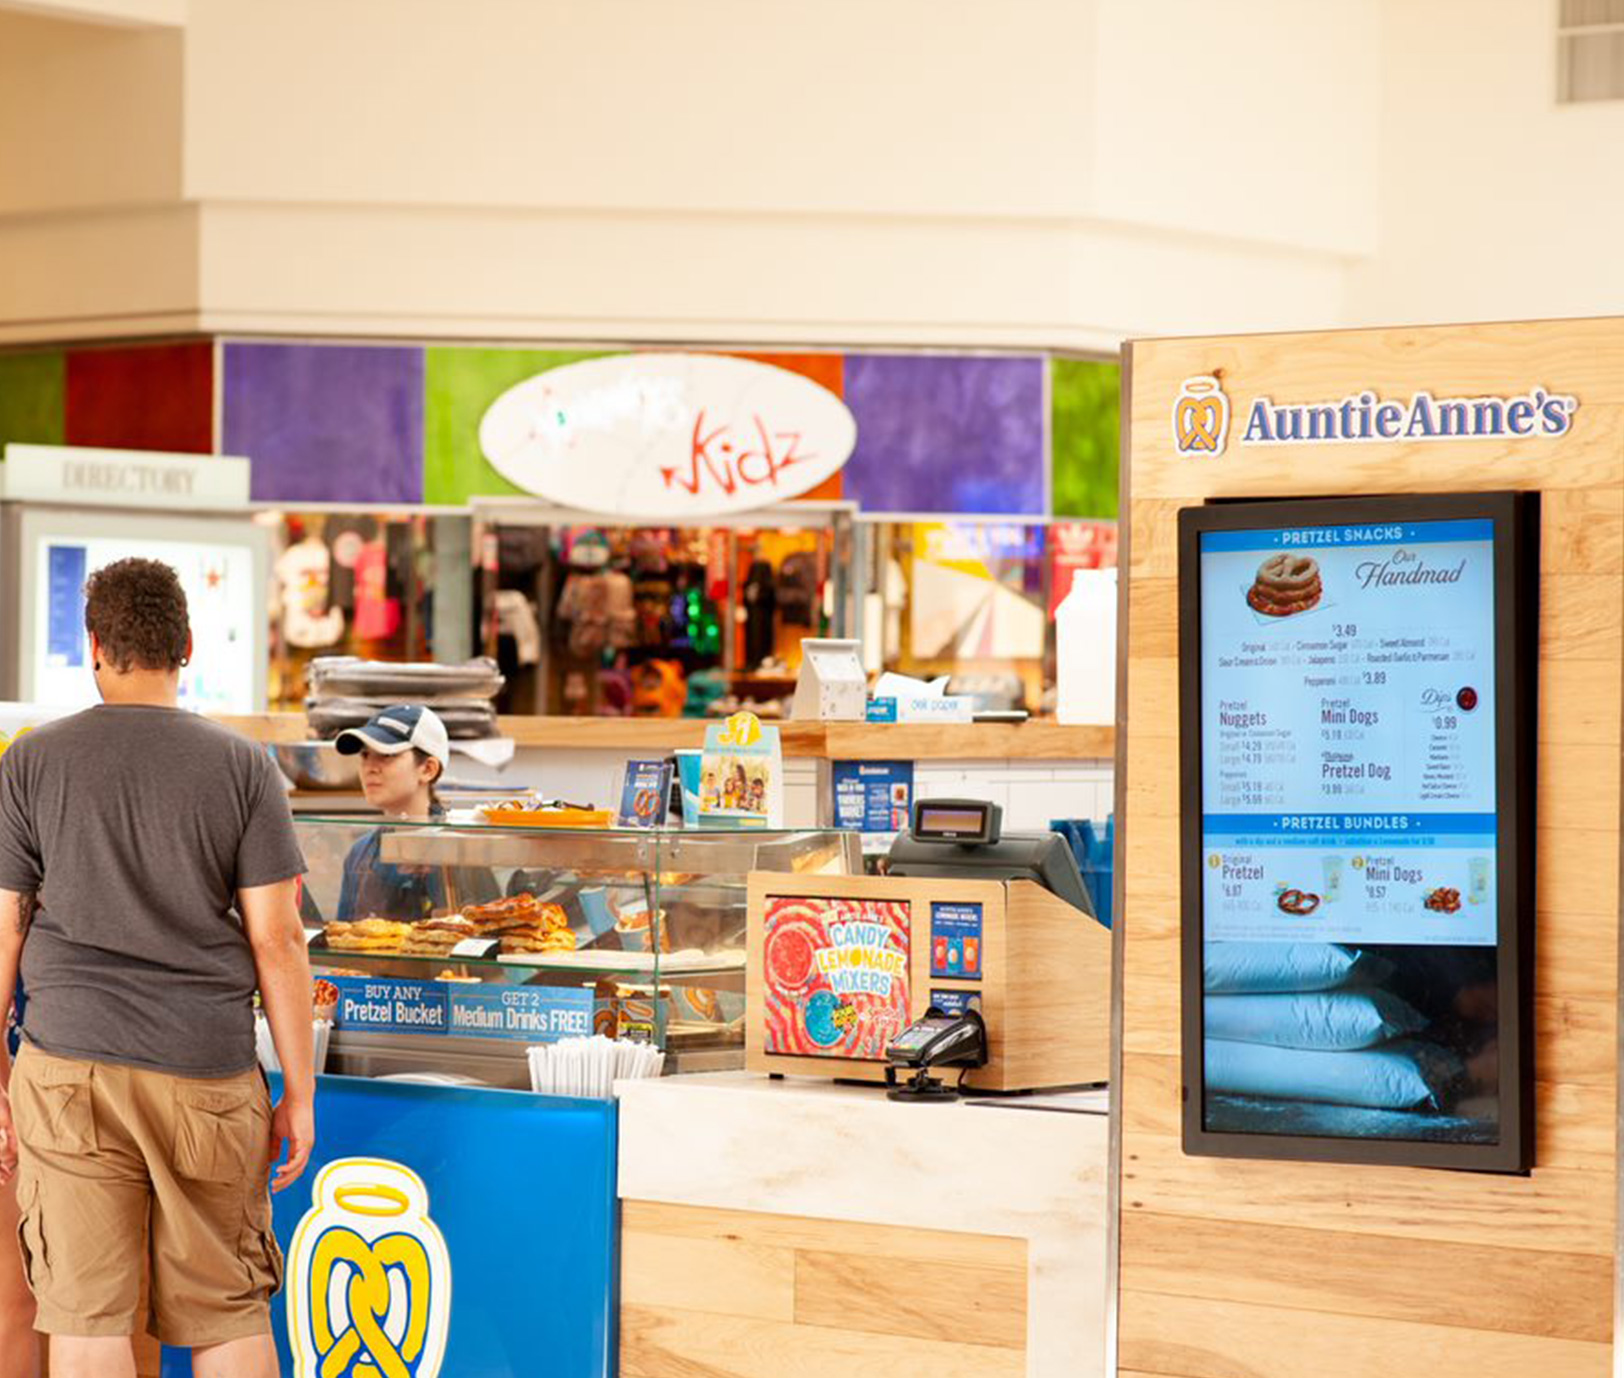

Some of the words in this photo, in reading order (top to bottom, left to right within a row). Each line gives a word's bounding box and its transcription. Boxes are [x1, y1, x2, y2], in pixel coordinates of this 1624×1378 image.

[661, 408, 818, 495] Kidz
[63, 461, 195, 495] DIRECTORY
[1282, 529, 1340, 545] PRETZEL
[1344, 526, 1403, 541] SNACKS
[1392, 549, 1416, 565] Our
[1219, 712, 1267, 729] Nuggets
[1321, 709, 1346, 724] Mini
[1349, 708, 1379, 727] Dogs
[1322, 763, 1365, 779] Pretzel
[1368, 763, 1391, 781] Dog
[1282, 816, 1340, 829] PRETZEL
[1344, 816, 1409, 829] BUNDLES
[1222, 865, 1264, 880] Pretzel
[1366, 867, 1390, 881] Mini
[1394, 866, 1423, 883] Dogs
[832, 924, 888, 948] CANDY
[365, 984, 391, 998] BUY
[394, 986, 422, 1000] ANY
[502, 990, 530, 1006] GET
[533, 992, 540, 1006] 2
[344, 999, 392, 1023] Pretzel
[395, 1002, 442, 1026] Bucket
[453, 1003, 503, 1029] Medium
[506, 1009, 548, 1031] Drinks
[550, 1009, 588, 1034] FREE!
